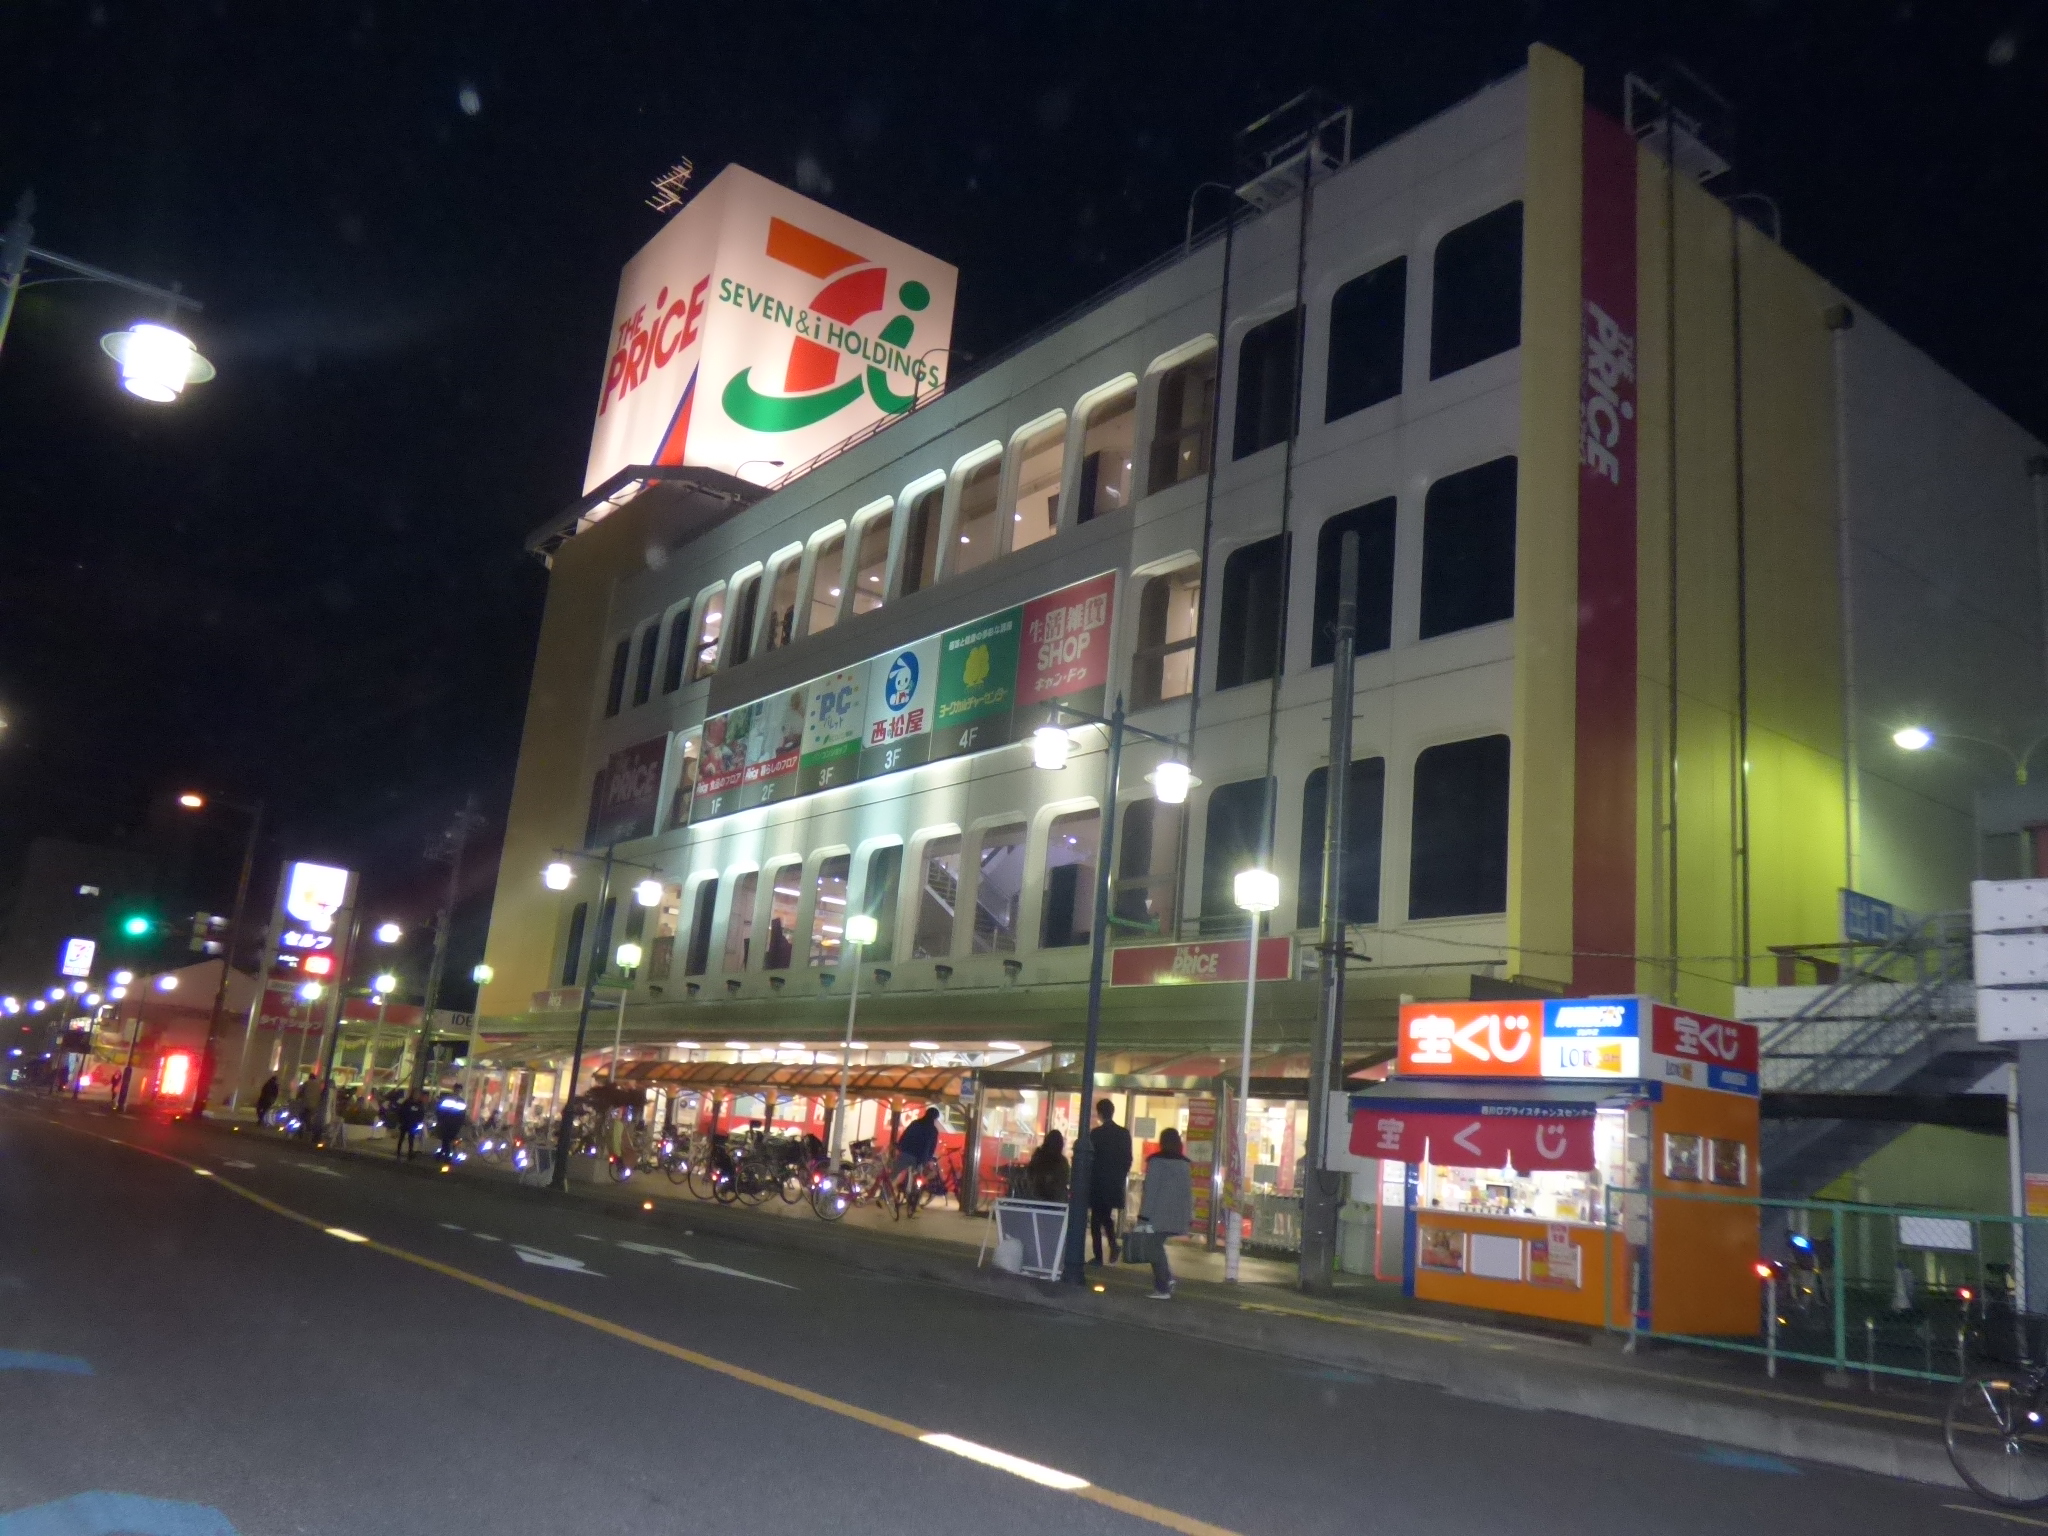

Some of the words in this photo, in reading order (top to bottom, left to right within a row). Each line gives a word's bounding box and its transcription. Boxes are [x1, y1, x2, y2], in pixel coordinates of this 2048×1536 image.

[617, 304, 646, 351] THE
[828, 322, 941, 389] HOLDINGS
[1037, 632, 1091, 672] SHOP
[817, 685, 852, 722] PC
[870, 708, 924, 744] 西松屋
[958, 726, 978, 748] 4F
[818, 766, 834, 786] 3F
[884, 748, 901, 769] 3F
[711, 797, 722, 815] 1F
[762, 783, 775, 801] 2F
[1410, 1015, 1531, 1063] 宝くじ
[1673, 1016, 1738, 1061] 宝くじ
